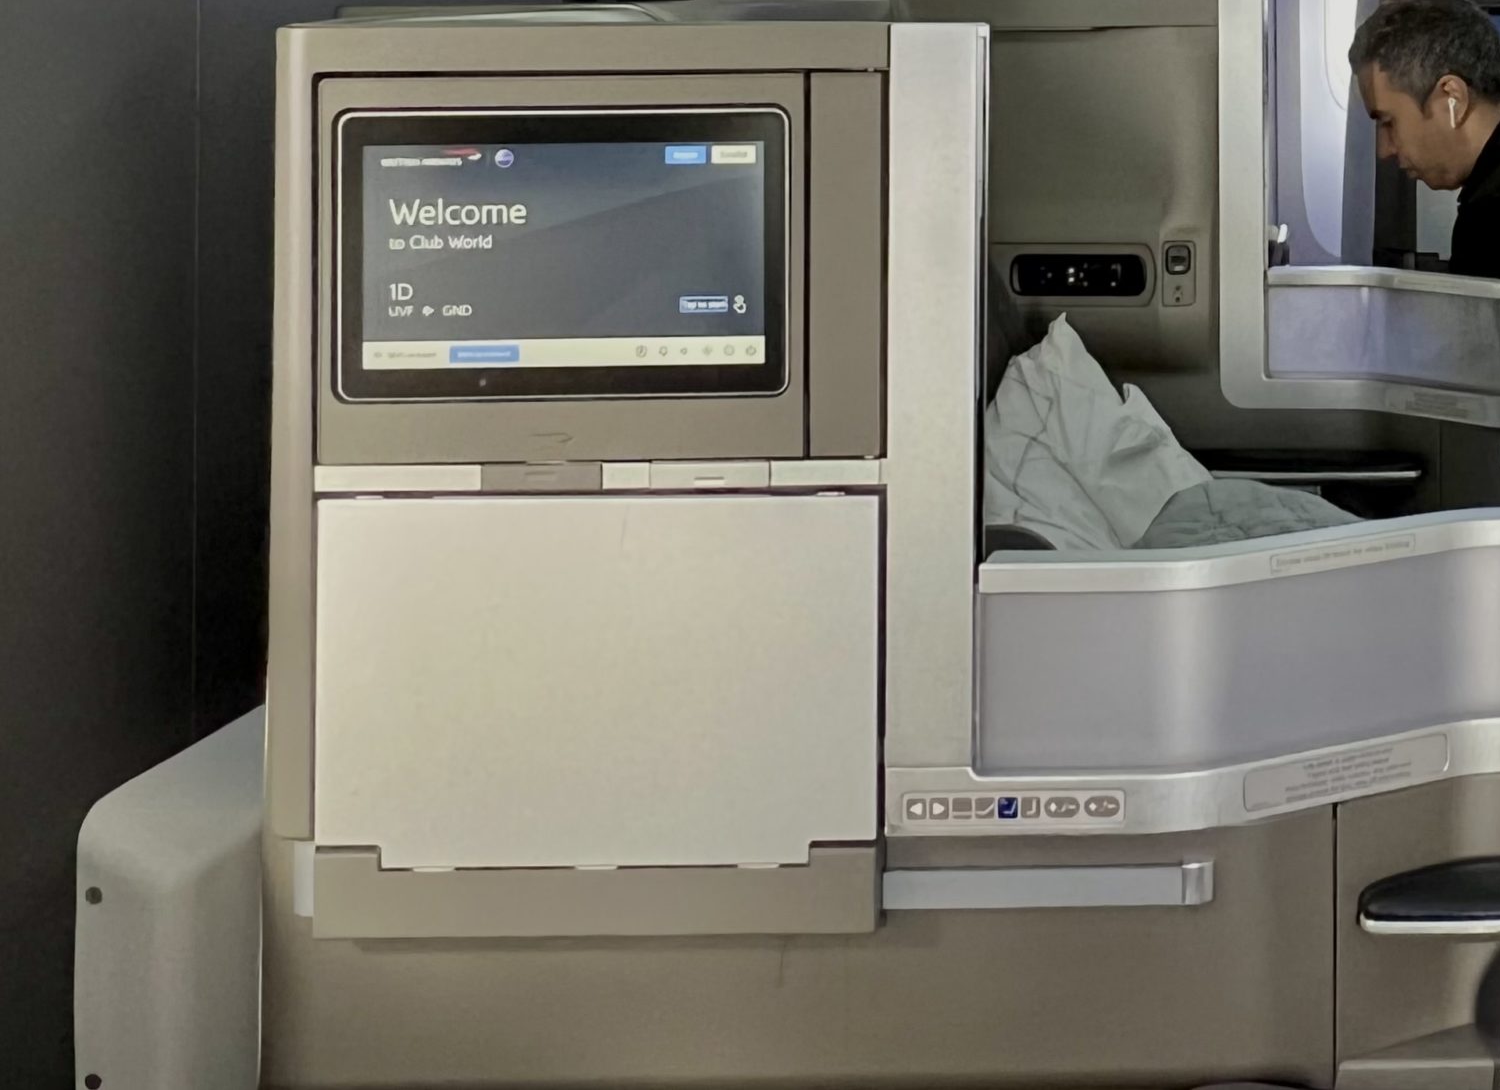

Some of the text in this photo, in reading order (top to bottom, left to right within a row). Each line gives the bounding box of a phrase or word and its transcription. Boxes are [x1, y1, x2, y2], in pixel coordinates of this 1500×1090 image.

[389, 197, 527, 225] Welcome
[388, 234, 493, 250] to Club World
[389, 283, 414, 301] 1D
[442, 304, 473, 317] GND
